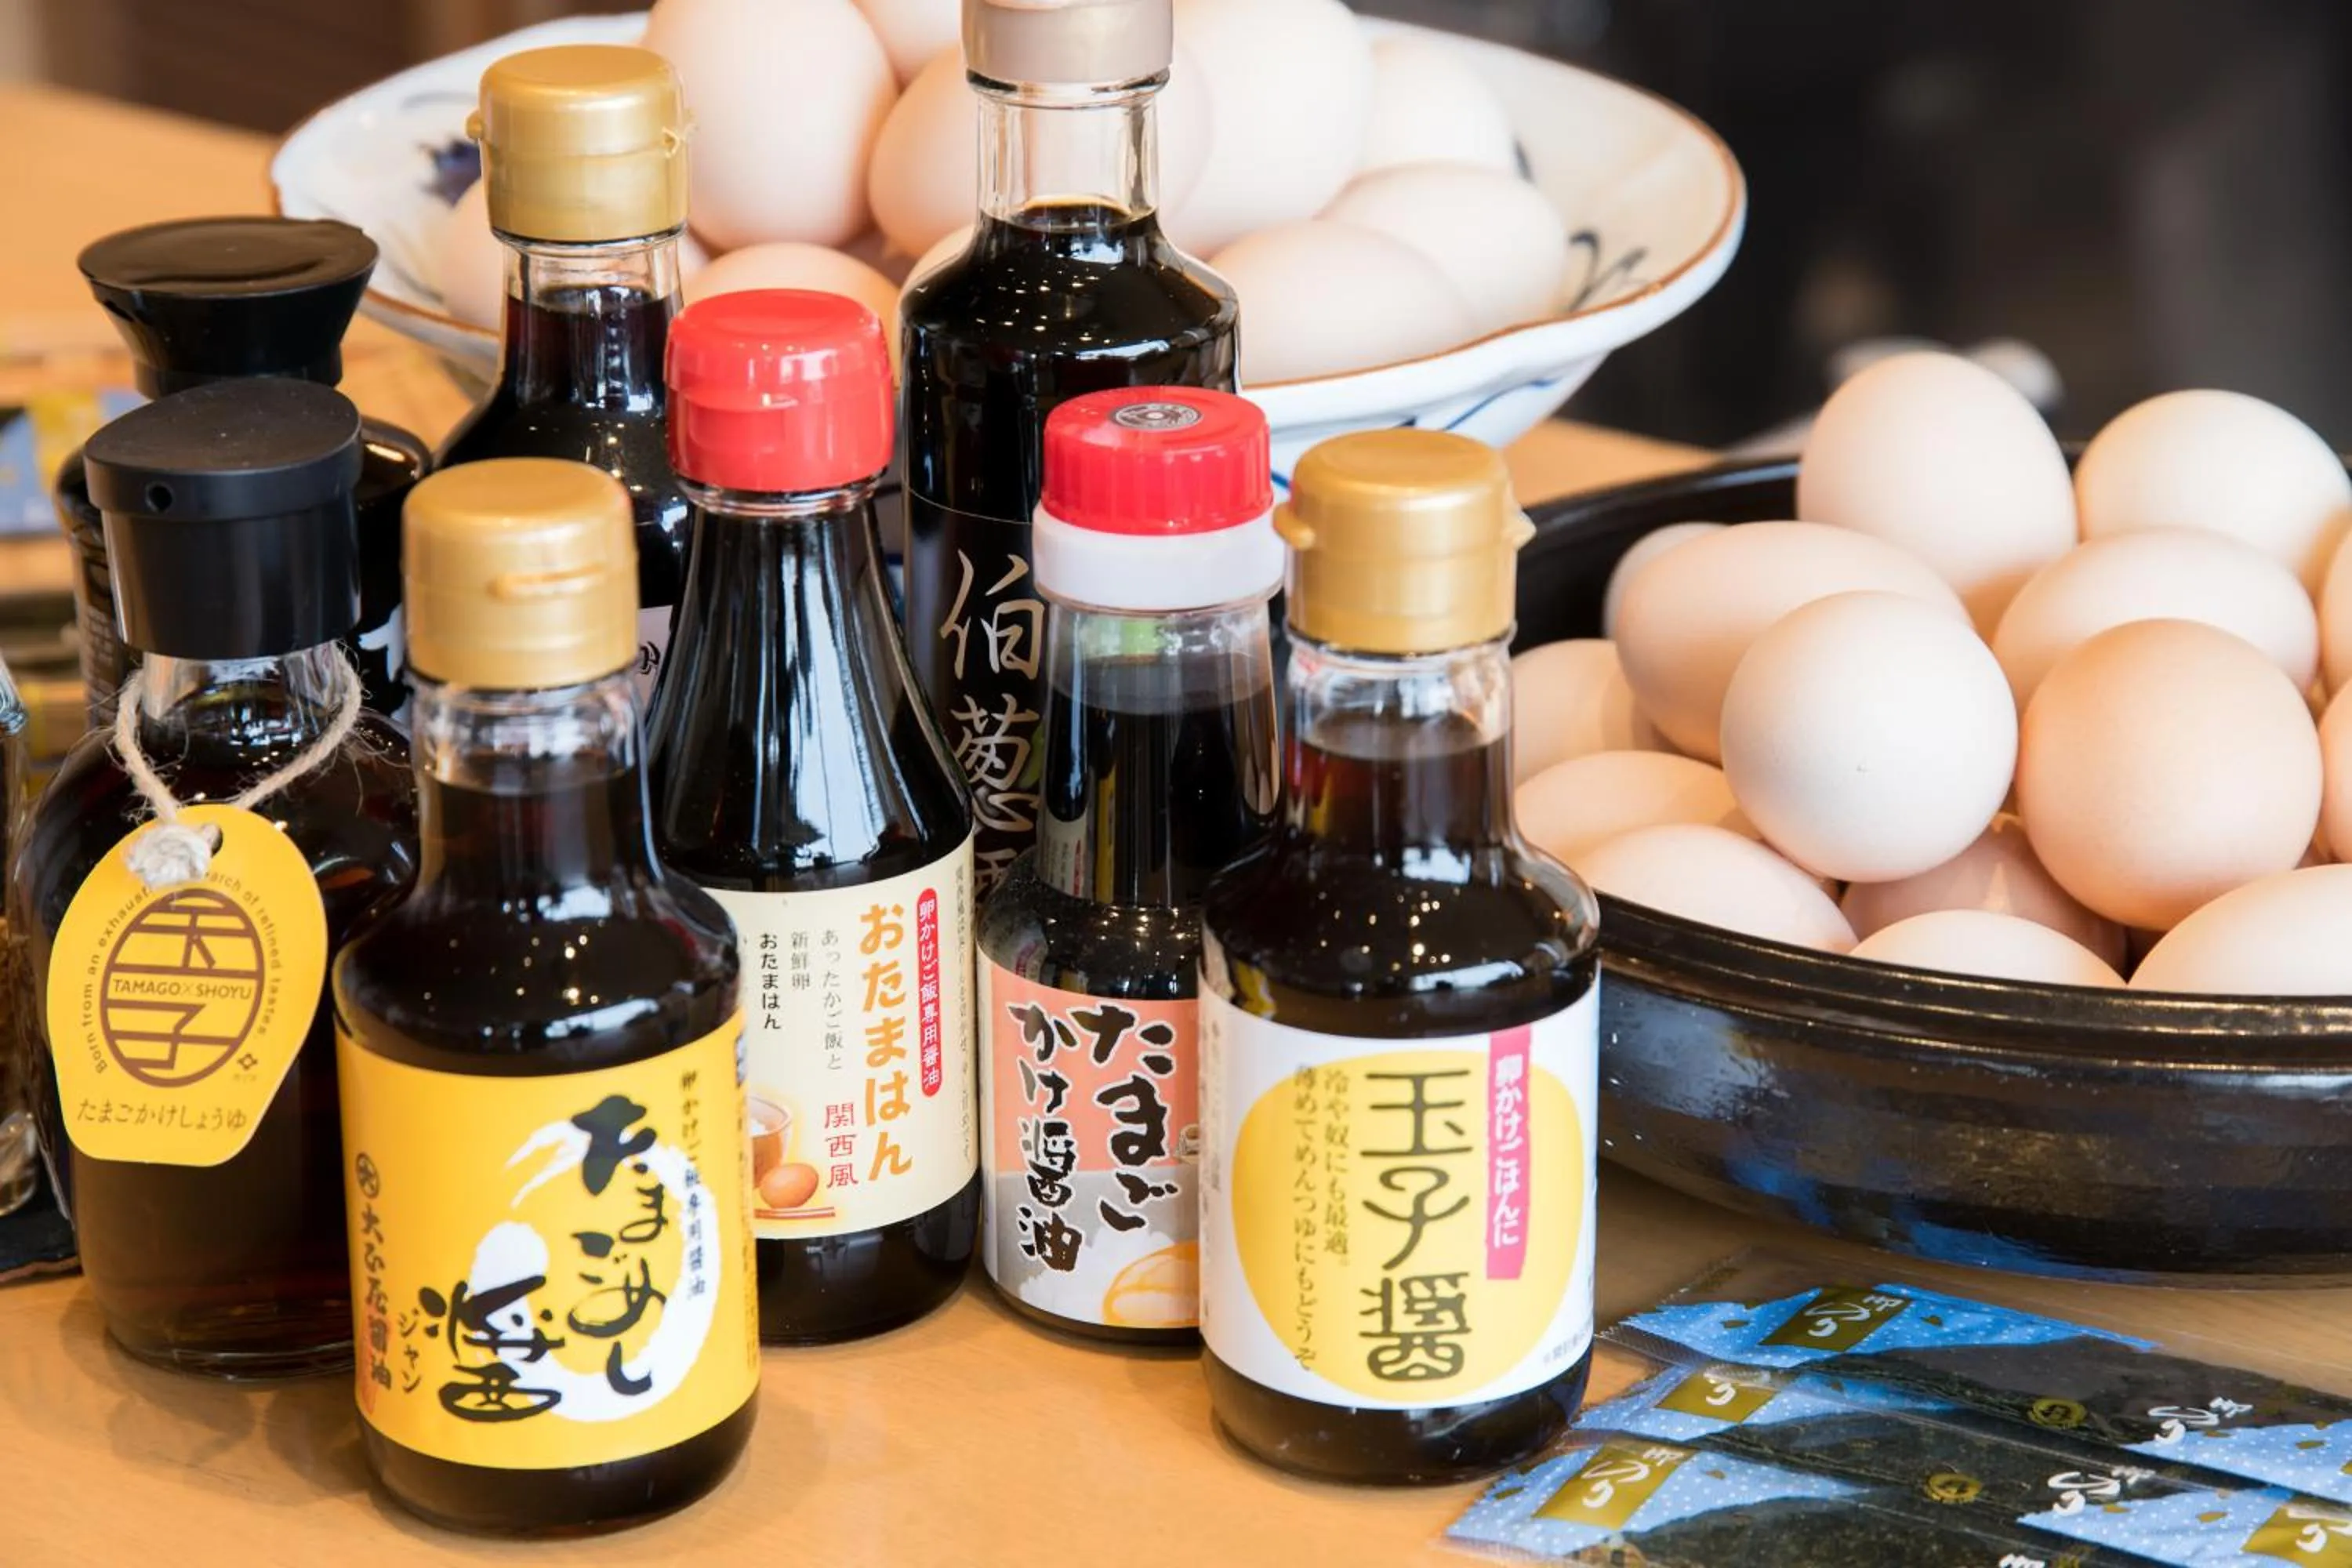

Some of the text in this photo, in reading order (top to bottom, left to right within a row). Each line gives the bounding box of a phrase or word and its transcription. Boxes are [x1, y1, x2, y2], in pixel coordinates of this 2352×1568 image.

[759, 933, 782, 1030] おたまはん
[791, 931, 811, 990] 新鮮卵
[820, 929, 844, 1072] あったかご飯と
[859, 902, 913, 1181] おたまはん
[824, 1102, 859, 1189] 関西風
[1066, 1004, 1178, 1233] たまご
